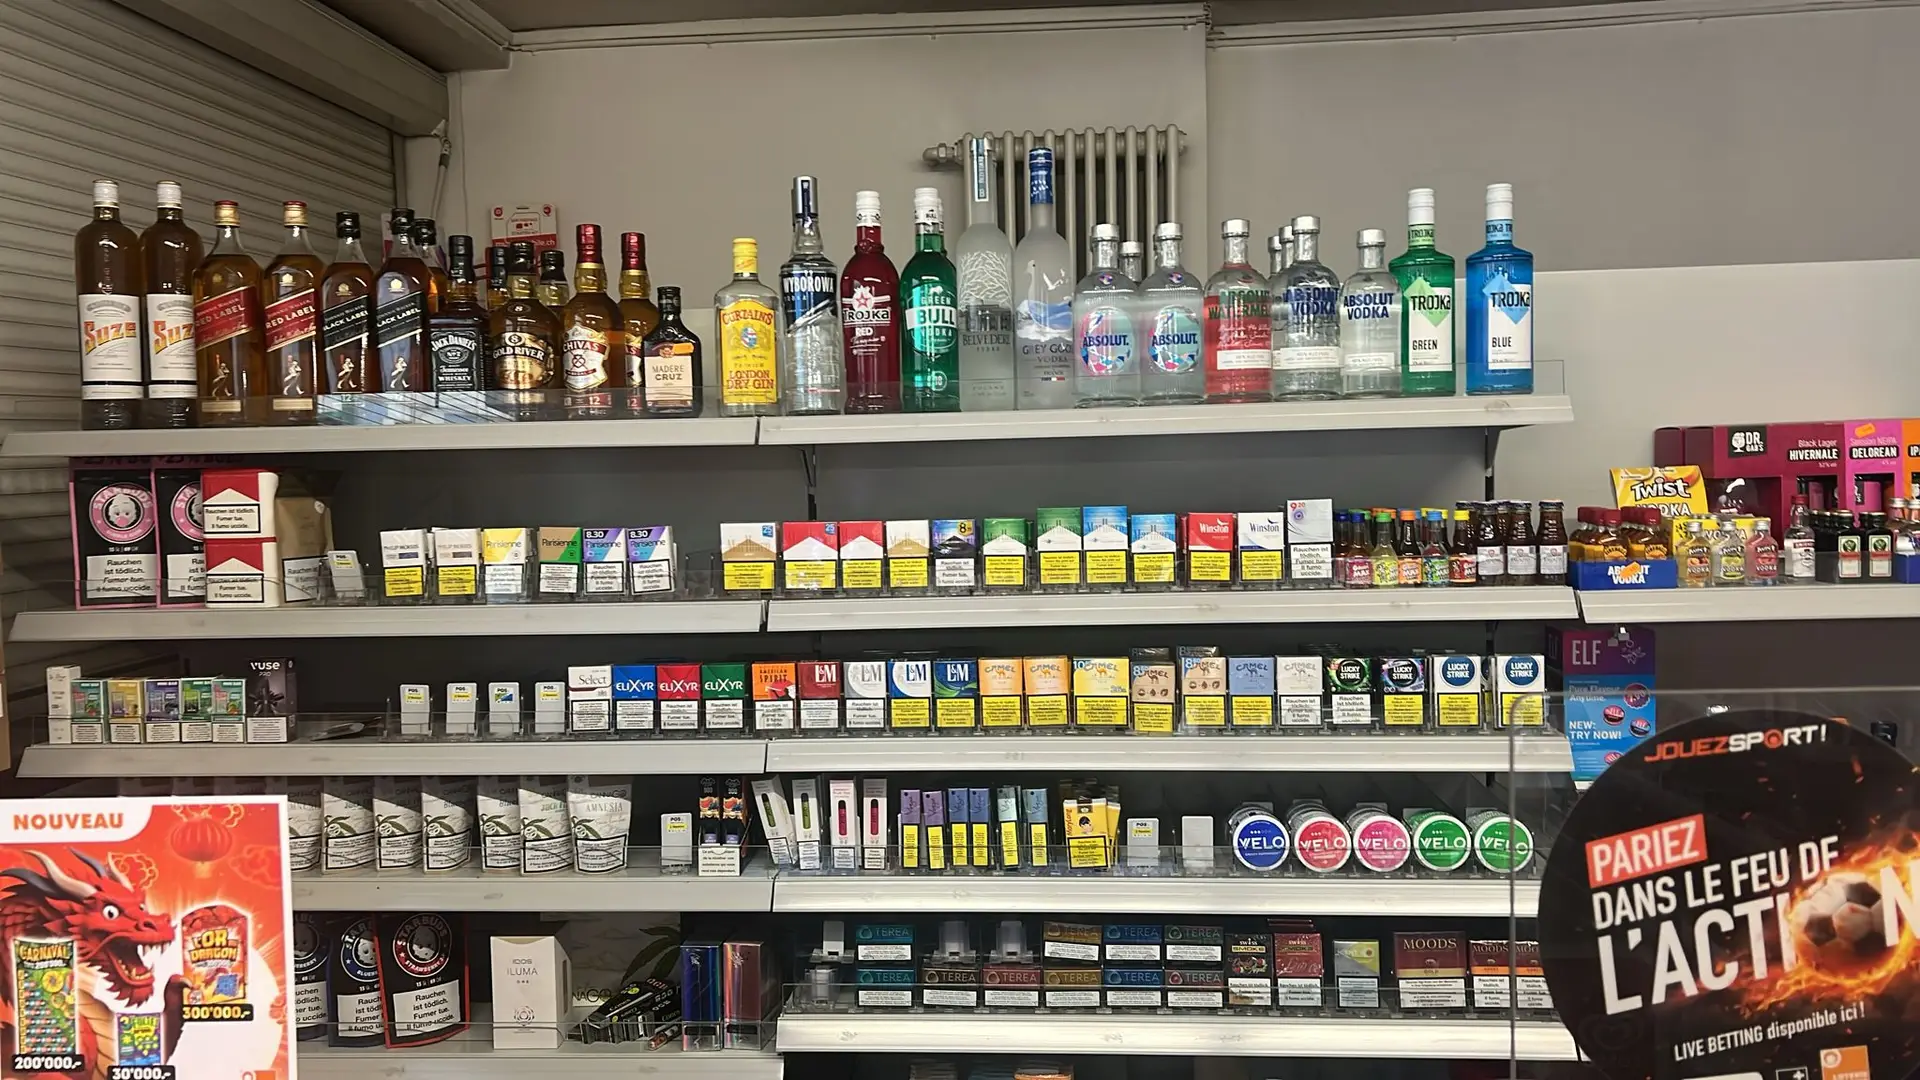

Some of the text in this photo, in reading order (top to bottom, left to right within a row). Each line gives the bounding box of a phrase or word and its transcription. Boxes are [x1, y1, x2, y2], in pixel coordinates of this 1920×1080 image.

[920, 297, 952, 305] GREEN
[1343, 292, 1394, 308] ABSOLUT
[214, 303, 245, 322] LABEL
[397, 307, 421, 321] LABEL
[1291, 301, 1336, 316] VODKA
[1347, 304, 1389, 320] VODKA
[266, 317, 285, 330] RED
[285, 306, 316, 322] LABEL
[346, 310, 369, 323] LABEL
[918, 308, 956, 326] BULL
[855, 327, 874, 337] RED
[921, 327, 953, 337] VODKA
[430, 334, 478, 352] JACK DANIEL'S
[562, 340, 600, 353] CHIVAS
[1412, 339, 1438, 351] GREEN
[1491, 336, 1512, 348] BLUE
[492, 346, 545, 361] GOLD RIVER
[654, 373, 683, 381] CRUZ
[729, 370, 770, 380] LONDON
[727, 379, 774, 390] DRY GIN
[588, 396, 601, 406] 12
[1745, 431, 1762, 445] DR.
[1798, 439, 1838, 448] Black Lager
[1789, 449, 1838, 461] HIVERNALE
[1852, 446, 1897, 458] DELOREAN
[1631, 477, 1691, 501] Twist
[762, 525, 773, 533] 25
[825, 523, 835, 531] 25
[1199, 522, 1229, 534] Winston
[1249, 522, 1280, 533] Winston
[585, 530, 604, 539] 8.30
[629, 530, 648, 538] 8.30
[541, 538, 578, 548] Parisienne
[585, 540, 621, 548] Parisienne
[630, 538, 666, 548] Parisienne
[1571, 639, 1602, 666] ELF
[250, 661, 281, 671] vuse
[984, 664, 1017, 673] CAMEL
[1029, 664, 1062, 673] CAMEL
[1236, 663, 1268, 672] CAMEL
[1340, 665, 1361, 673] LUCKY
[1510, 662, 1533, 670] LUCKY
[814, 665, 837, 683] L&M
[861, 664, 882, 682] L&M
[906, 664, 927, 682] L&M
[947, 664, 969, 682] L&M
[1339, 672, 1361, 680] STRIKE
[1446, 670, 1470, 678] STRIKE
[1509, 670, 1534, 678] STRIKE
[578, 674, 607, 685] Select
[759, 675, 788, 683] SPIRIT
[1569, 721, 1596, 730] NEW:
[1570, 730, 1622, 740] TRY NOW!
[13, 812, 124, 831] NOUVEAU
[1238, 836, 1286, 850] VELO
[1299, 836, 1348, 852] VELO
[1358, 836, 1407, 851] VELO
[1420, 836, 1467, 850] VELO
[1481, 835, 1529, 855] VELO
[1591, 819, 1700, 883] PARIEZ
[1592, 875, 1678, 930] DANS
[1684, 863, 1725, 909] LE
[1730, 847, 1791, 896] FEU
[875, 927, 909, 936] TEREA
[1064, 925, 1098, 937] TEREA
[1123, 927, 1158, 936] TEREA
[1185, 928, 1221, 939] TEREA
[1403, 938, 1457, 950] MOODS
[1472, 945, 1509, 953] MOODS
[506, 967, 538, 976] ILUMA
[876, 972, 910, 983] TEREA
[940, 972, 976, 983] TEREA
[1002, 972, 1038, 983] TEREA
[1063, 973, 1099, 983] TEREA
[1124, 972, 1160, 983] TEREA
[1184, 972, 1221, 984] TEREA
[415, 989, 446, 1002] Rauchen
[413, 998, 449, 1011] ist tödlich.
[413, 1008, 450, 1020] Fumer tue.
[1674, 1034, 1706, 1062] LIVE
[1708, 1025, 1764, 1056] BETTING
[1767, 1011, 1838, 1041] disponible
